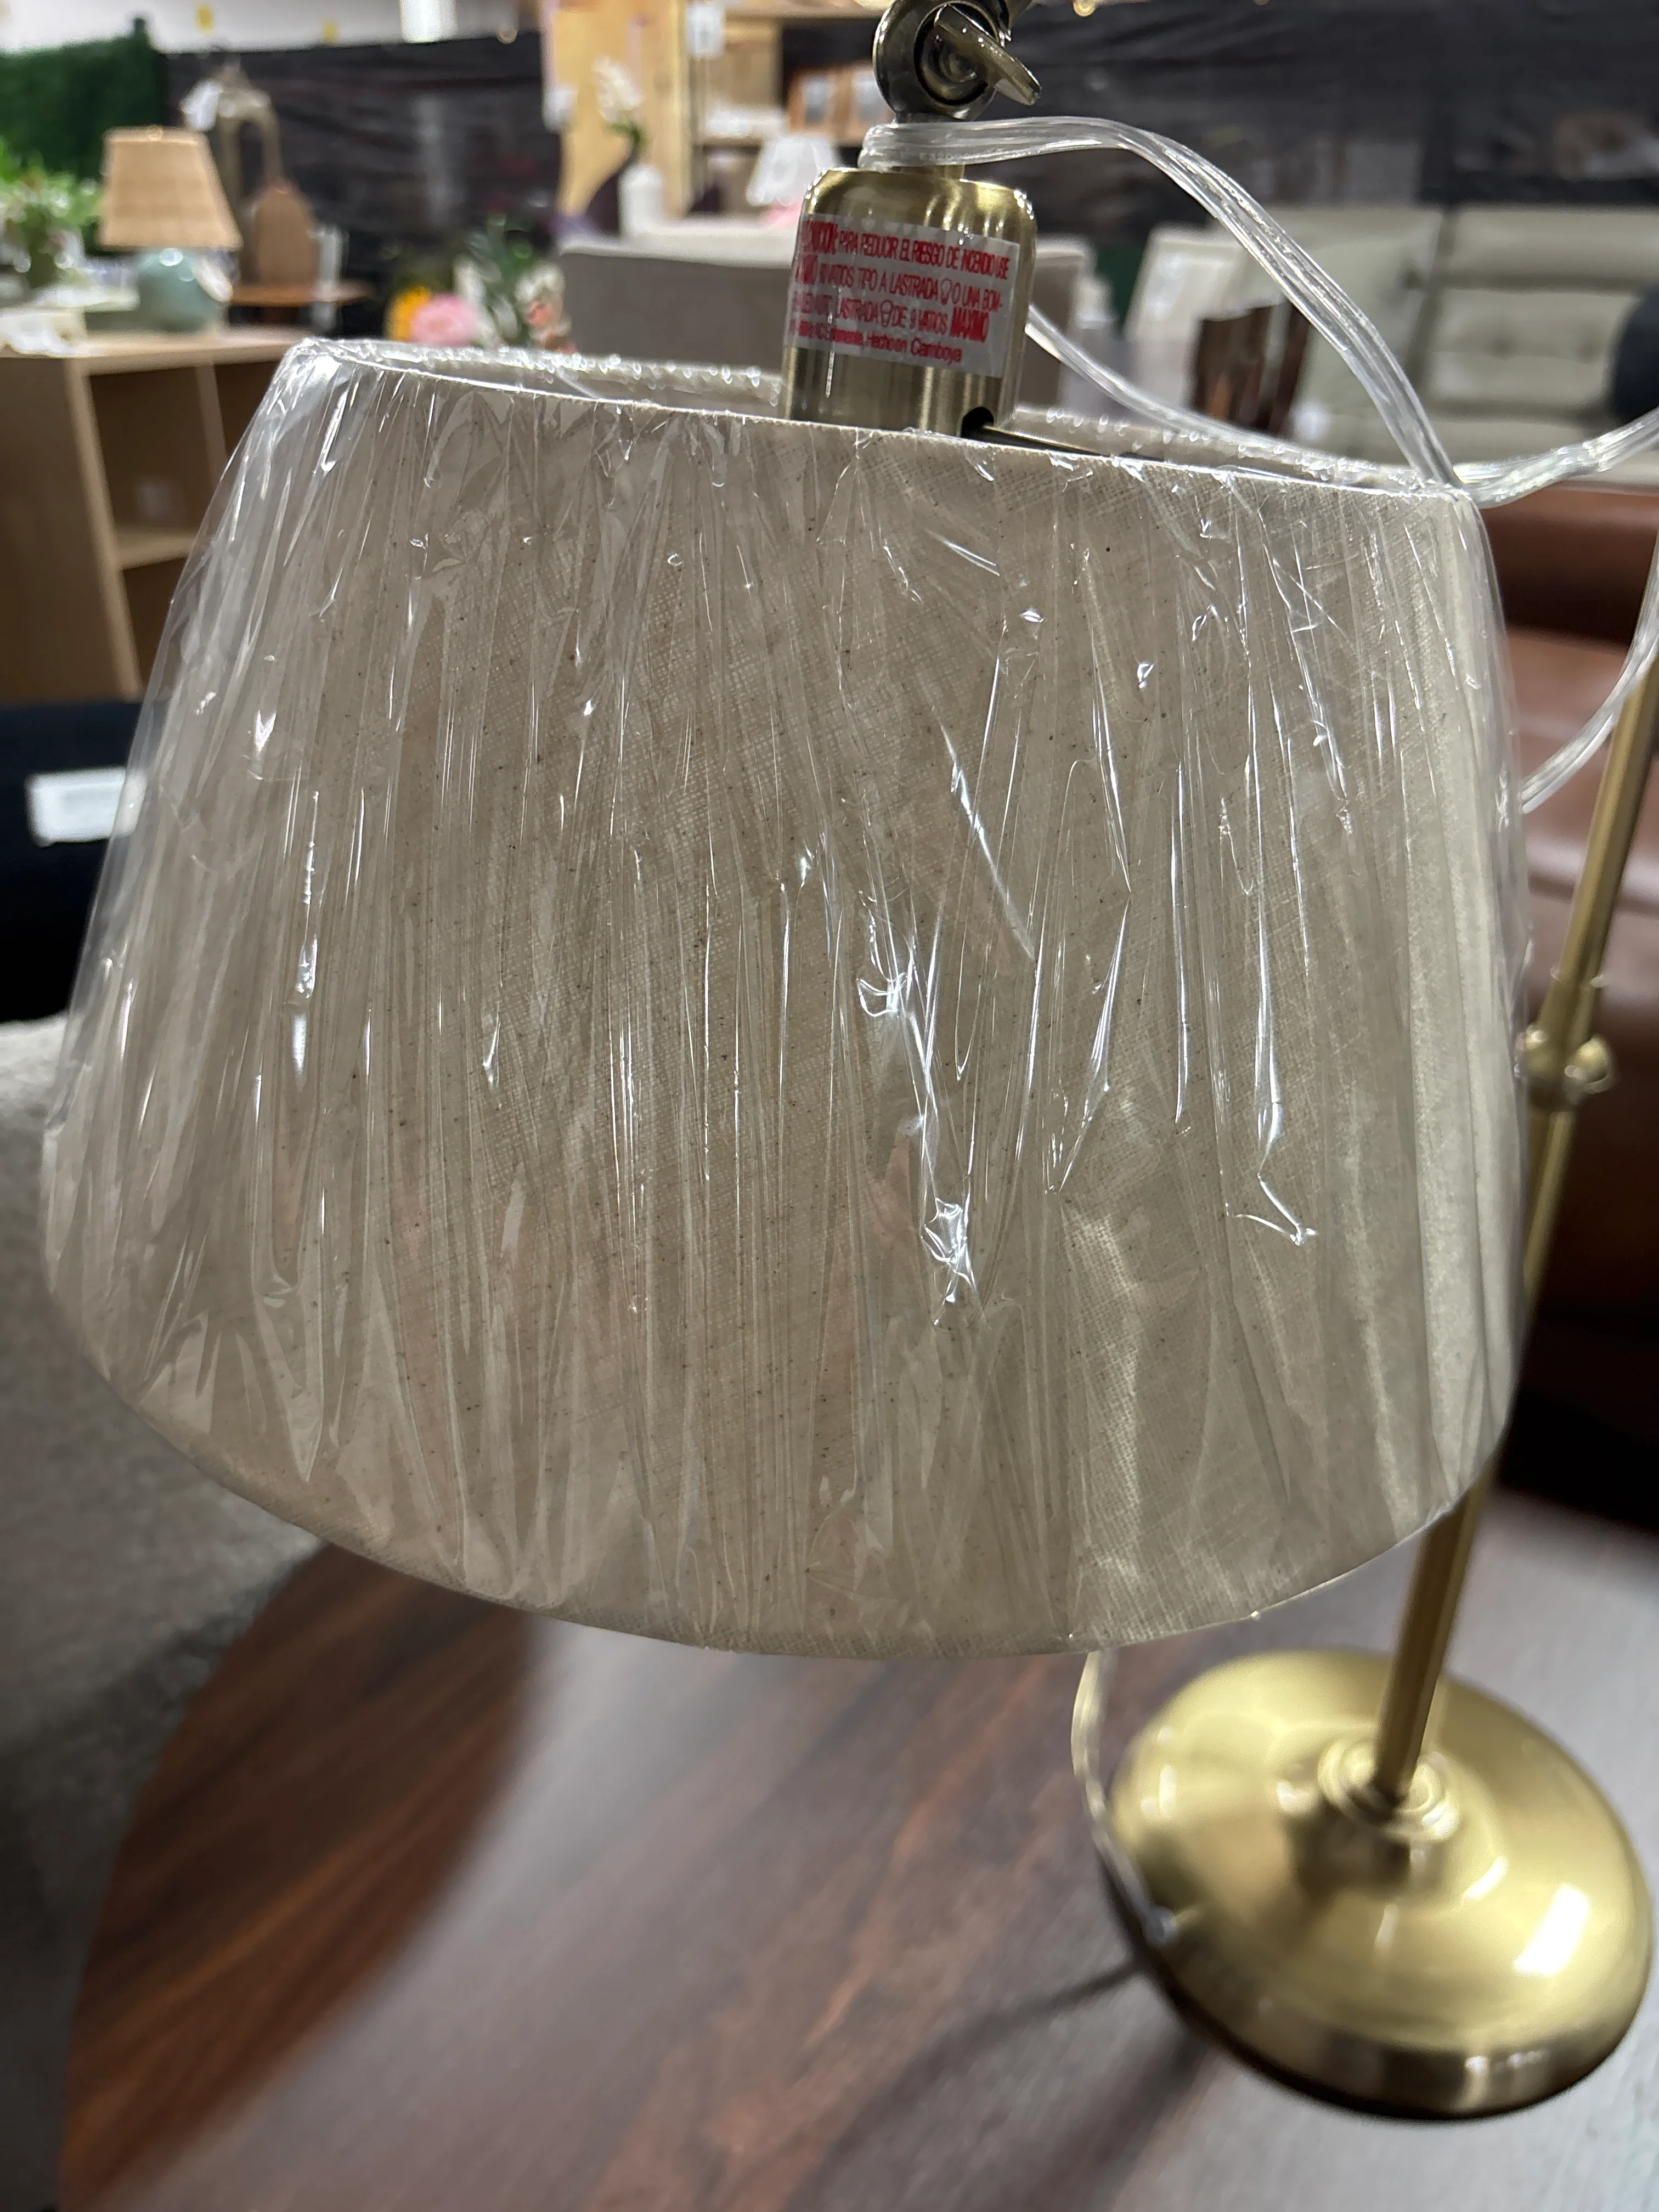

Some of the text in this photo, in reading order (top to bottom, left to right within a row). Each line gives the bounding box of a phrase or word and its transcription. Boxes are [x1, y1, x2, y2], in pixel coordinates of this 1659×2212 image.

[900, 238, 910, 262] EL
[946, 246, 960, 270] DE
[857, 267, 878, 291] TIPO
[879, 269, 887, 293] A
[951, 282, 961, 305] O
[891, 304, 908, 329] DE
